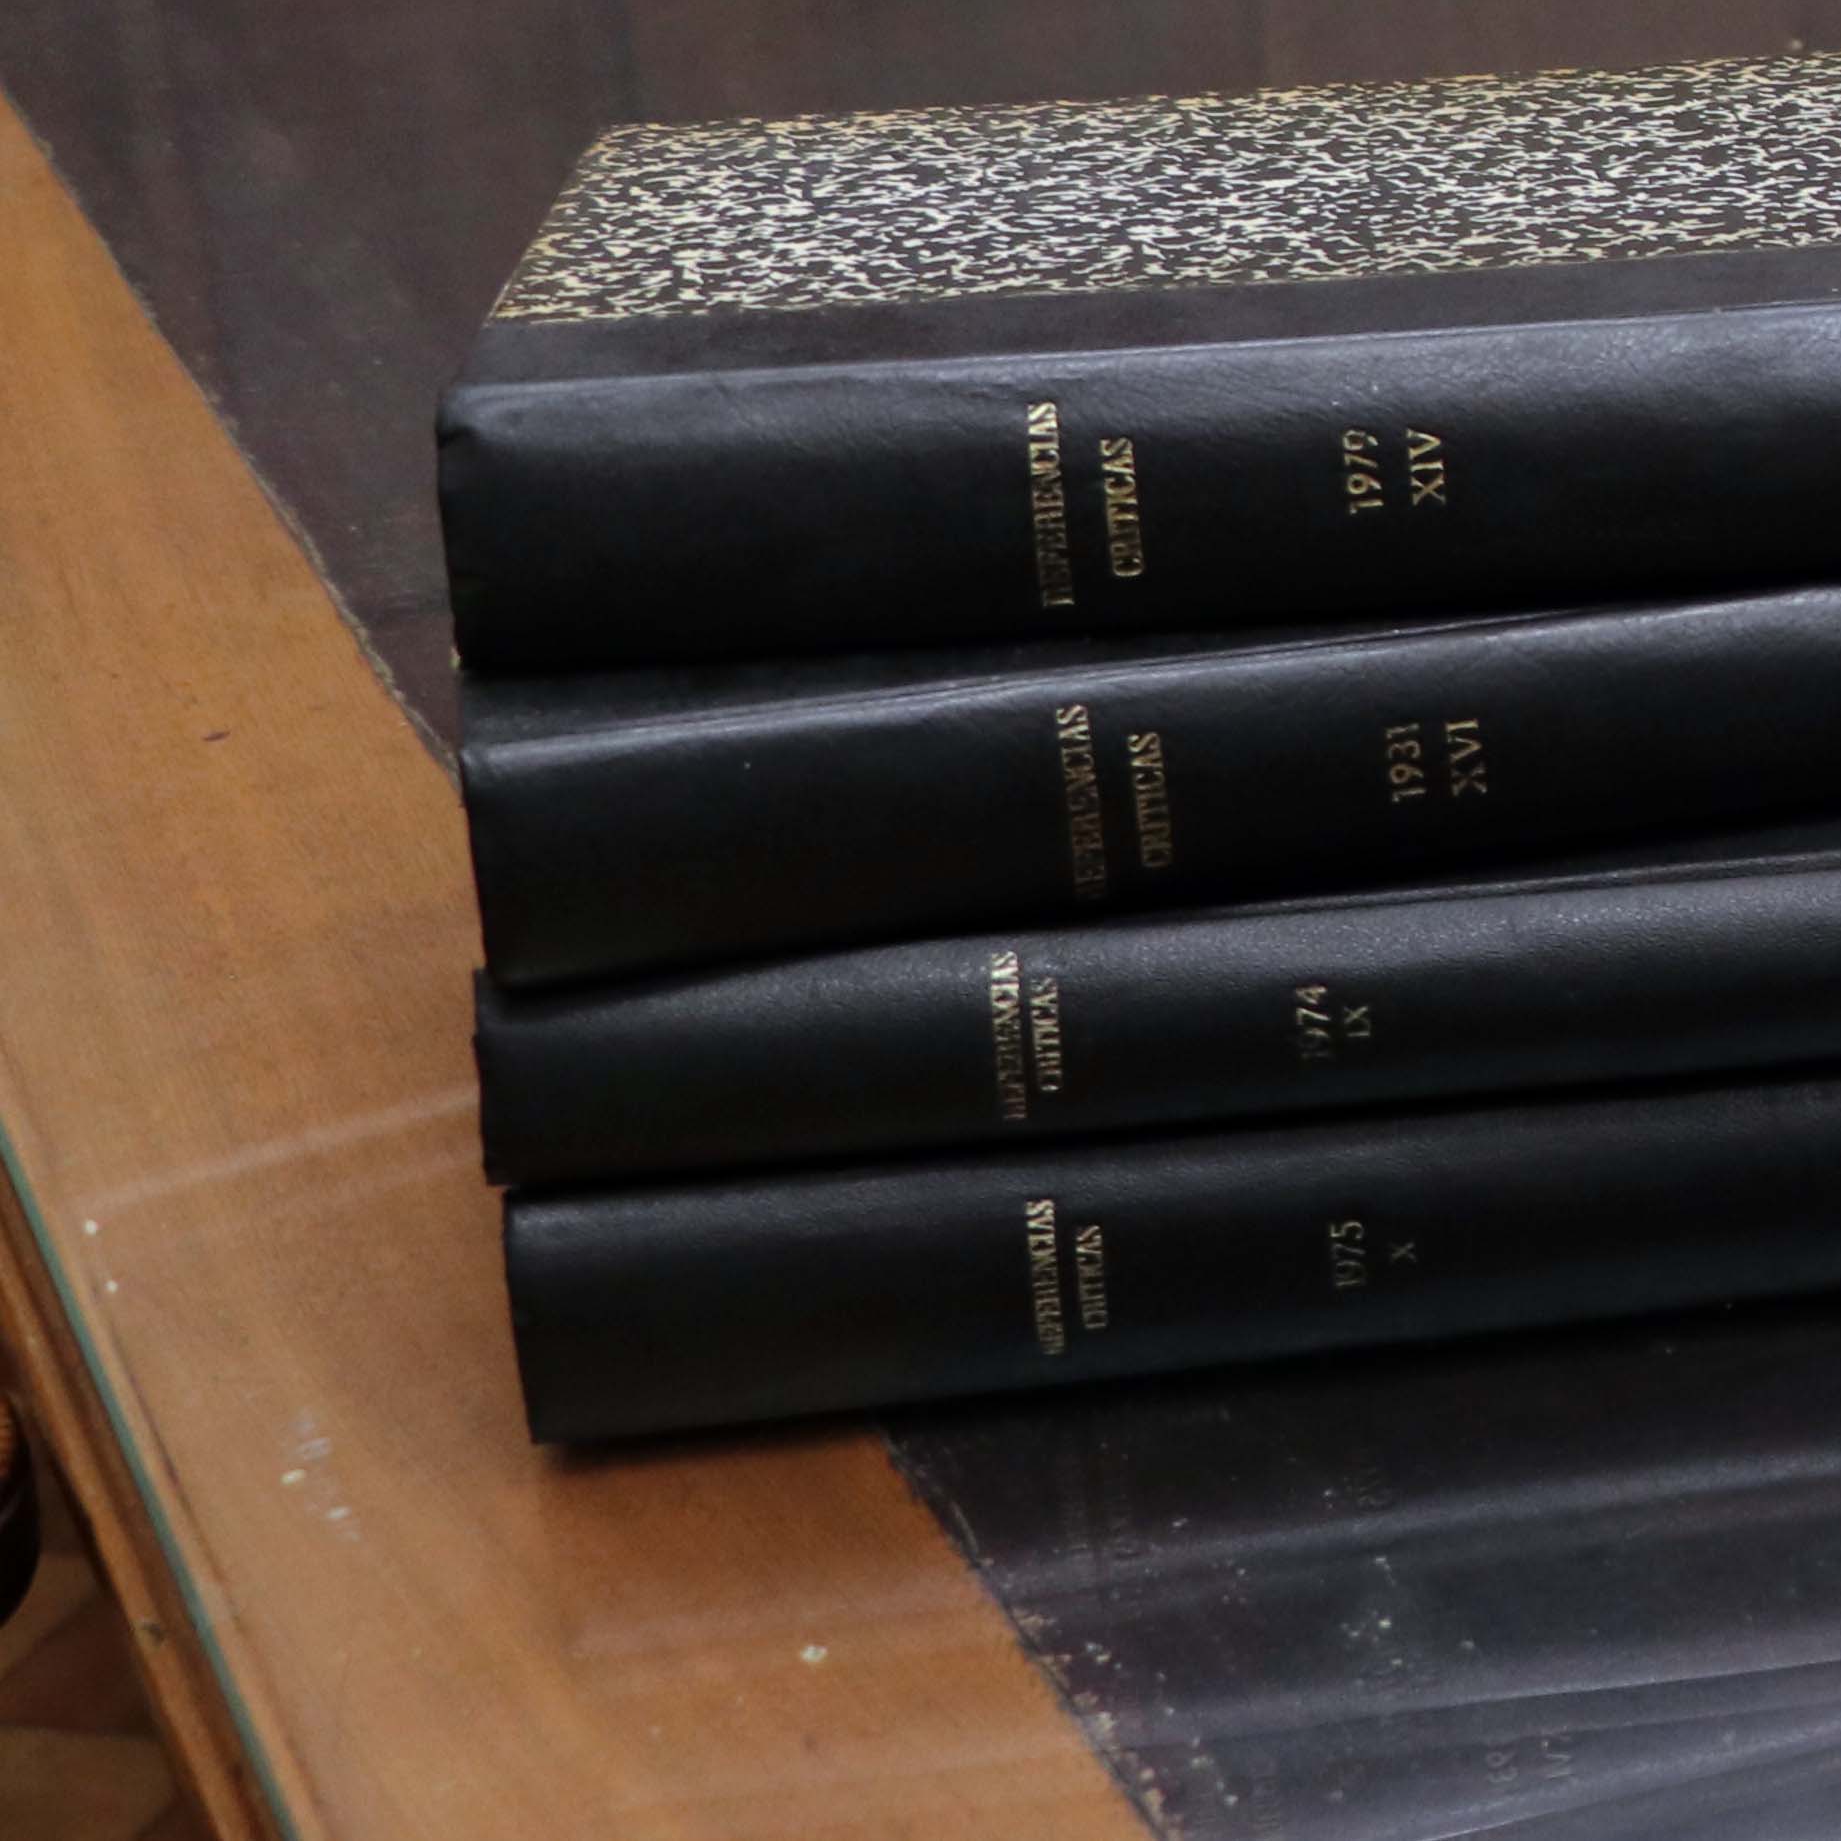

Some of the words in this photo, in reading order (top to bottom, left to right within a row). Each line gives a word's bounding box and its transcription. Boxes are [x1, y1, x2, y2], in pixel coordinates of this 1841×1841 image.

[1101, 436, 1145, 577] CRITICAS
[1342, 429, 1385, 515] 1979
[1407, 428, 1447, 507] XIV
[1444, 718, 1487, 797] XVI
[1127, 731, 1174, 869] CRITICAS
[1330, 1220, 1366, 1289] 1975
